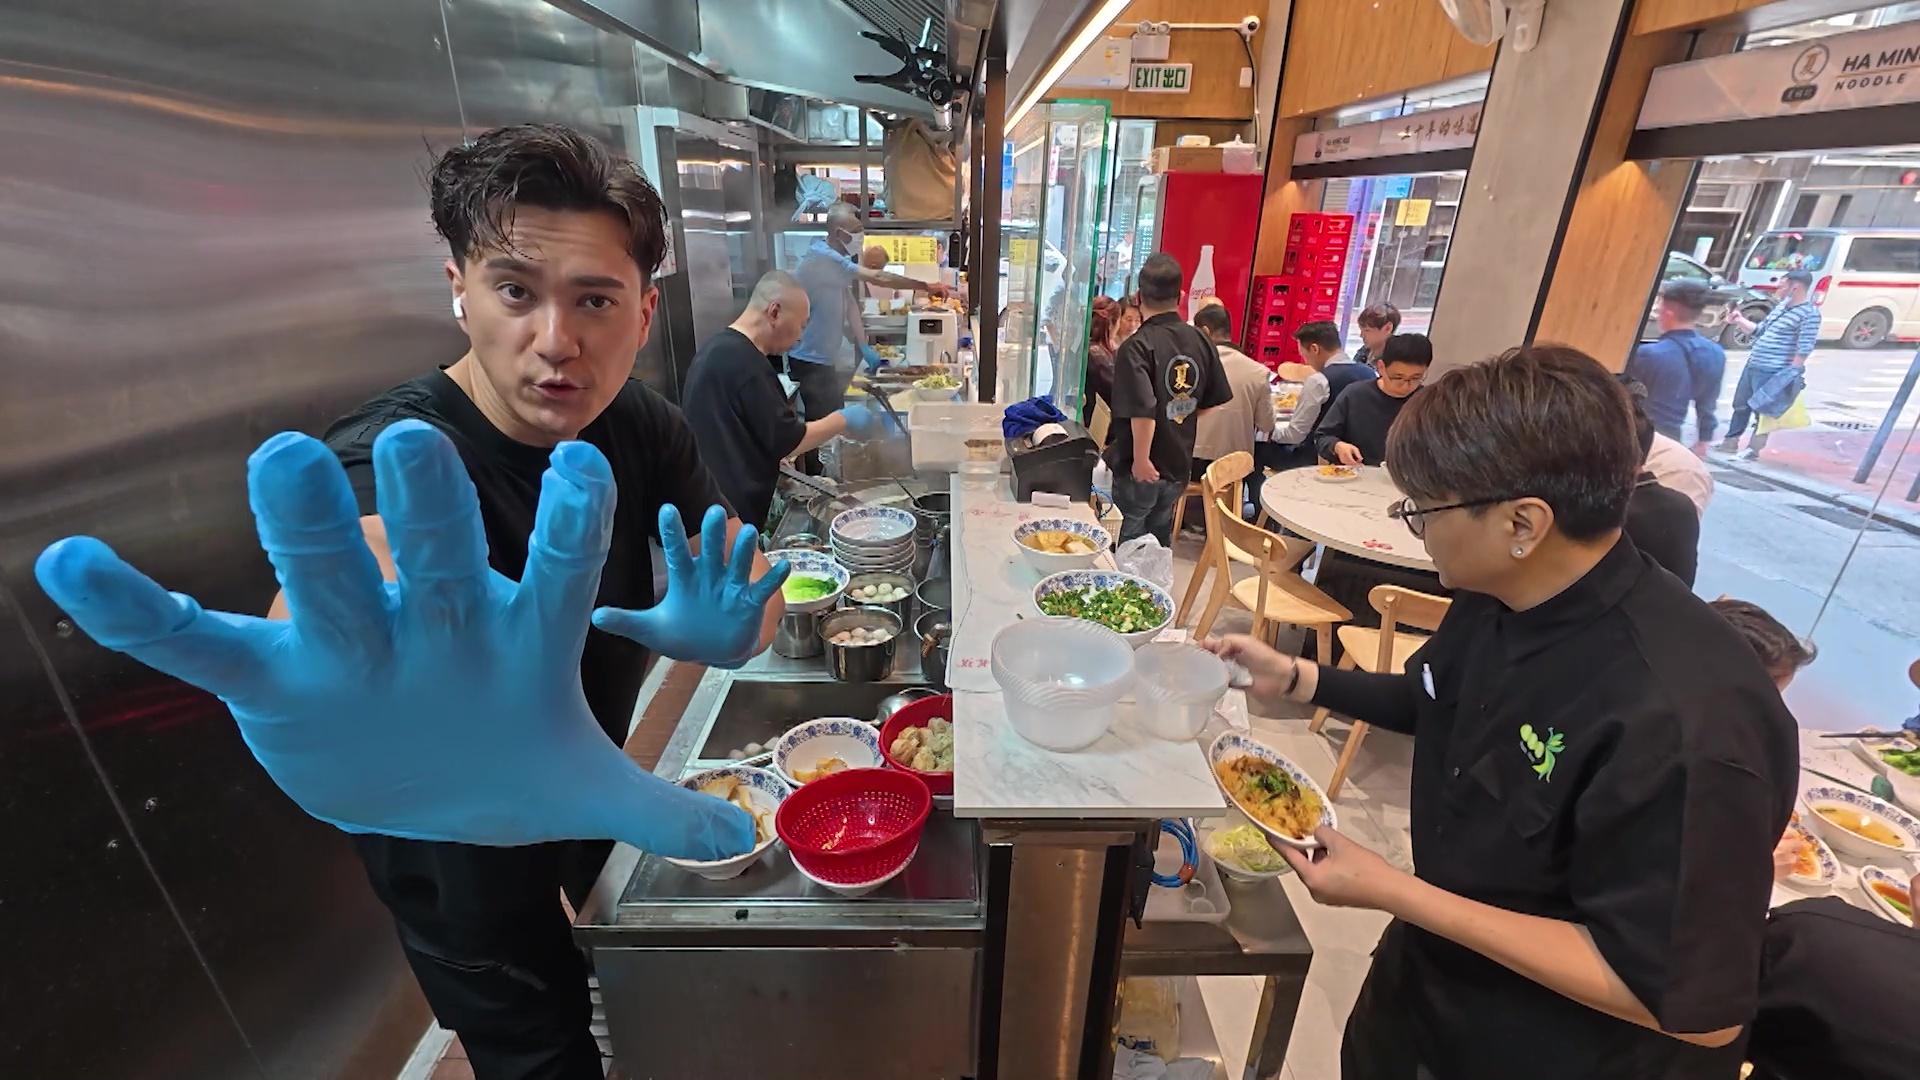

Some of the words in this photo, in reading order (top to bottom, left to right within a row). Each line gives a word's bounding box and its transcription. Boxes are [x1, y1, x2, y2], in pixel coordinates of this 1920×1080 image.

[1842, 53, 1871, 72] HA
[1876, 46, 1920, 68] MIN
[1135, 67, 1162, 88] EXIT
[1163, 67, 1186, 88] 出口
[1834, 73, 1908, 91] NOODLE
[1173, 362, 1193, 390] 夏
